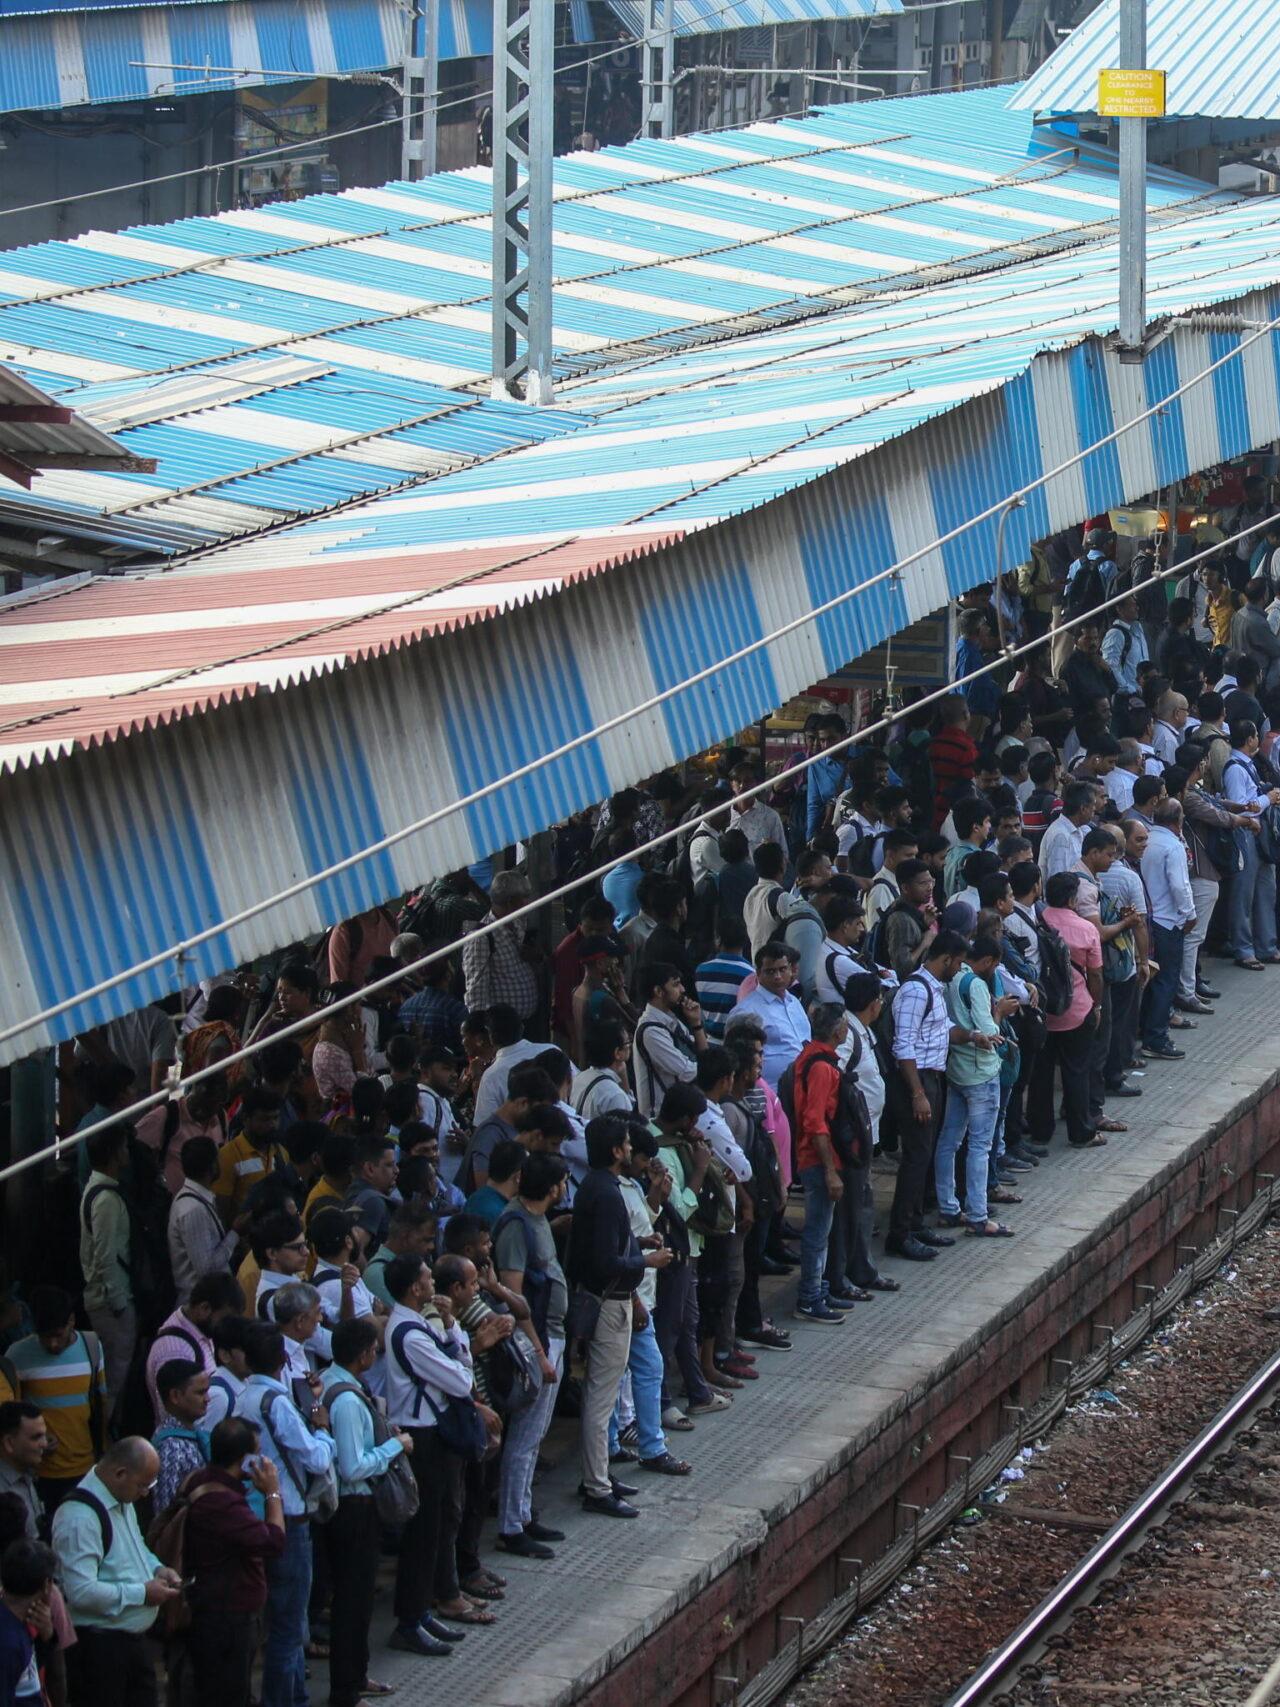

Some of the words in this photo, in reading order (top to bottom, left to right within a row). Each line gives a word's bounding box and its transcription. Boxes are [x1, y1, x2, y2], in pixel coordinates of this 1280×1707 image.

[1109, 72, 1152, 81] CAUTION
[1107, 81, 1153, 89] CLEARANCE
[1124, 89, 1136, 97] TO
[1103, 104, 1157, 113] RESTRICTED
